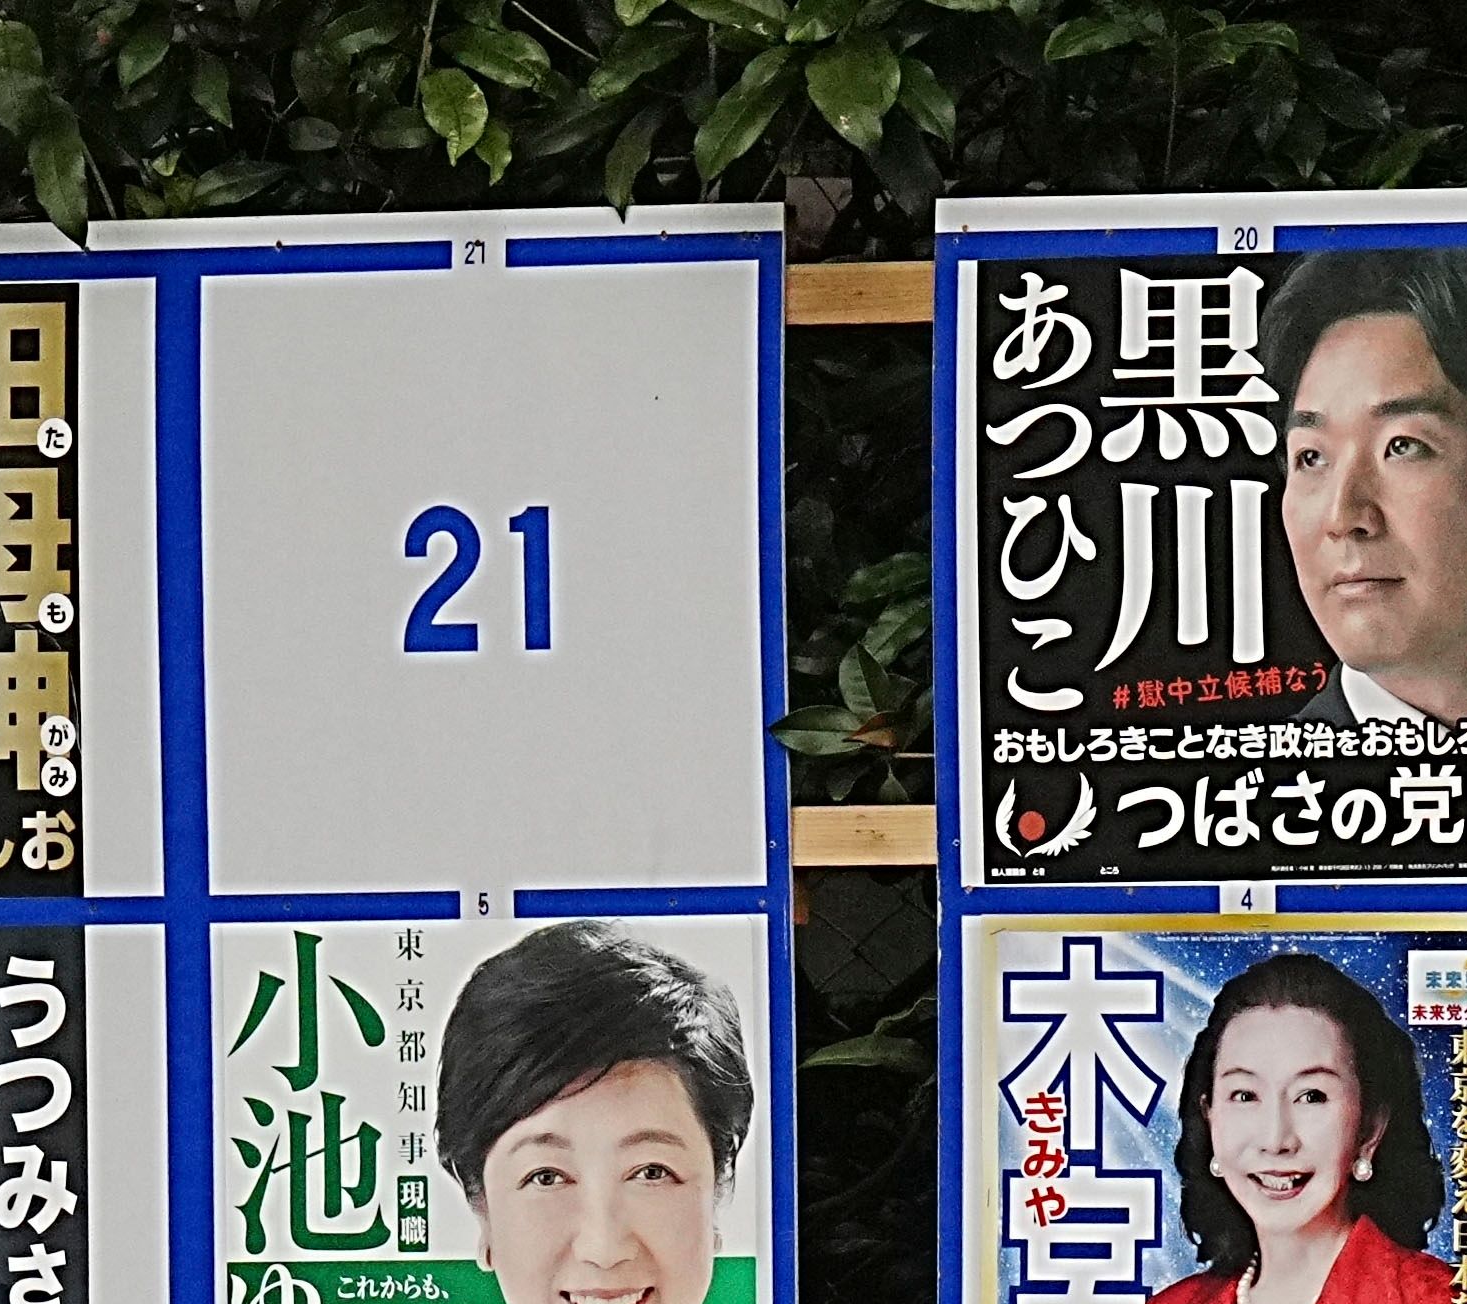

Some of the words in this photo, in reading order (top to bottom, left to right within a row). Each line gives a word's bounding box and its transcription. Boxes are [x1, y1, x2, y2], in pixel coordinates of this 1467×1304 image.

[465, 241, 485, 264] 21
[986, 272, 1096, 711] あつひこ
[1095, 266, 1279, 672] 黒川
[405, 507, 549, 652] 21
[1116, 763, 1464, 848] つばさの党
[479, 893, 489, 915] 5
[395, 929, 425, 1165] 東京都知事
[1024, 1091, 1068, 1226] きみや
[400, 1179, 427, 1249] 現職
[338, 1276, 450, 1299] これからも、
